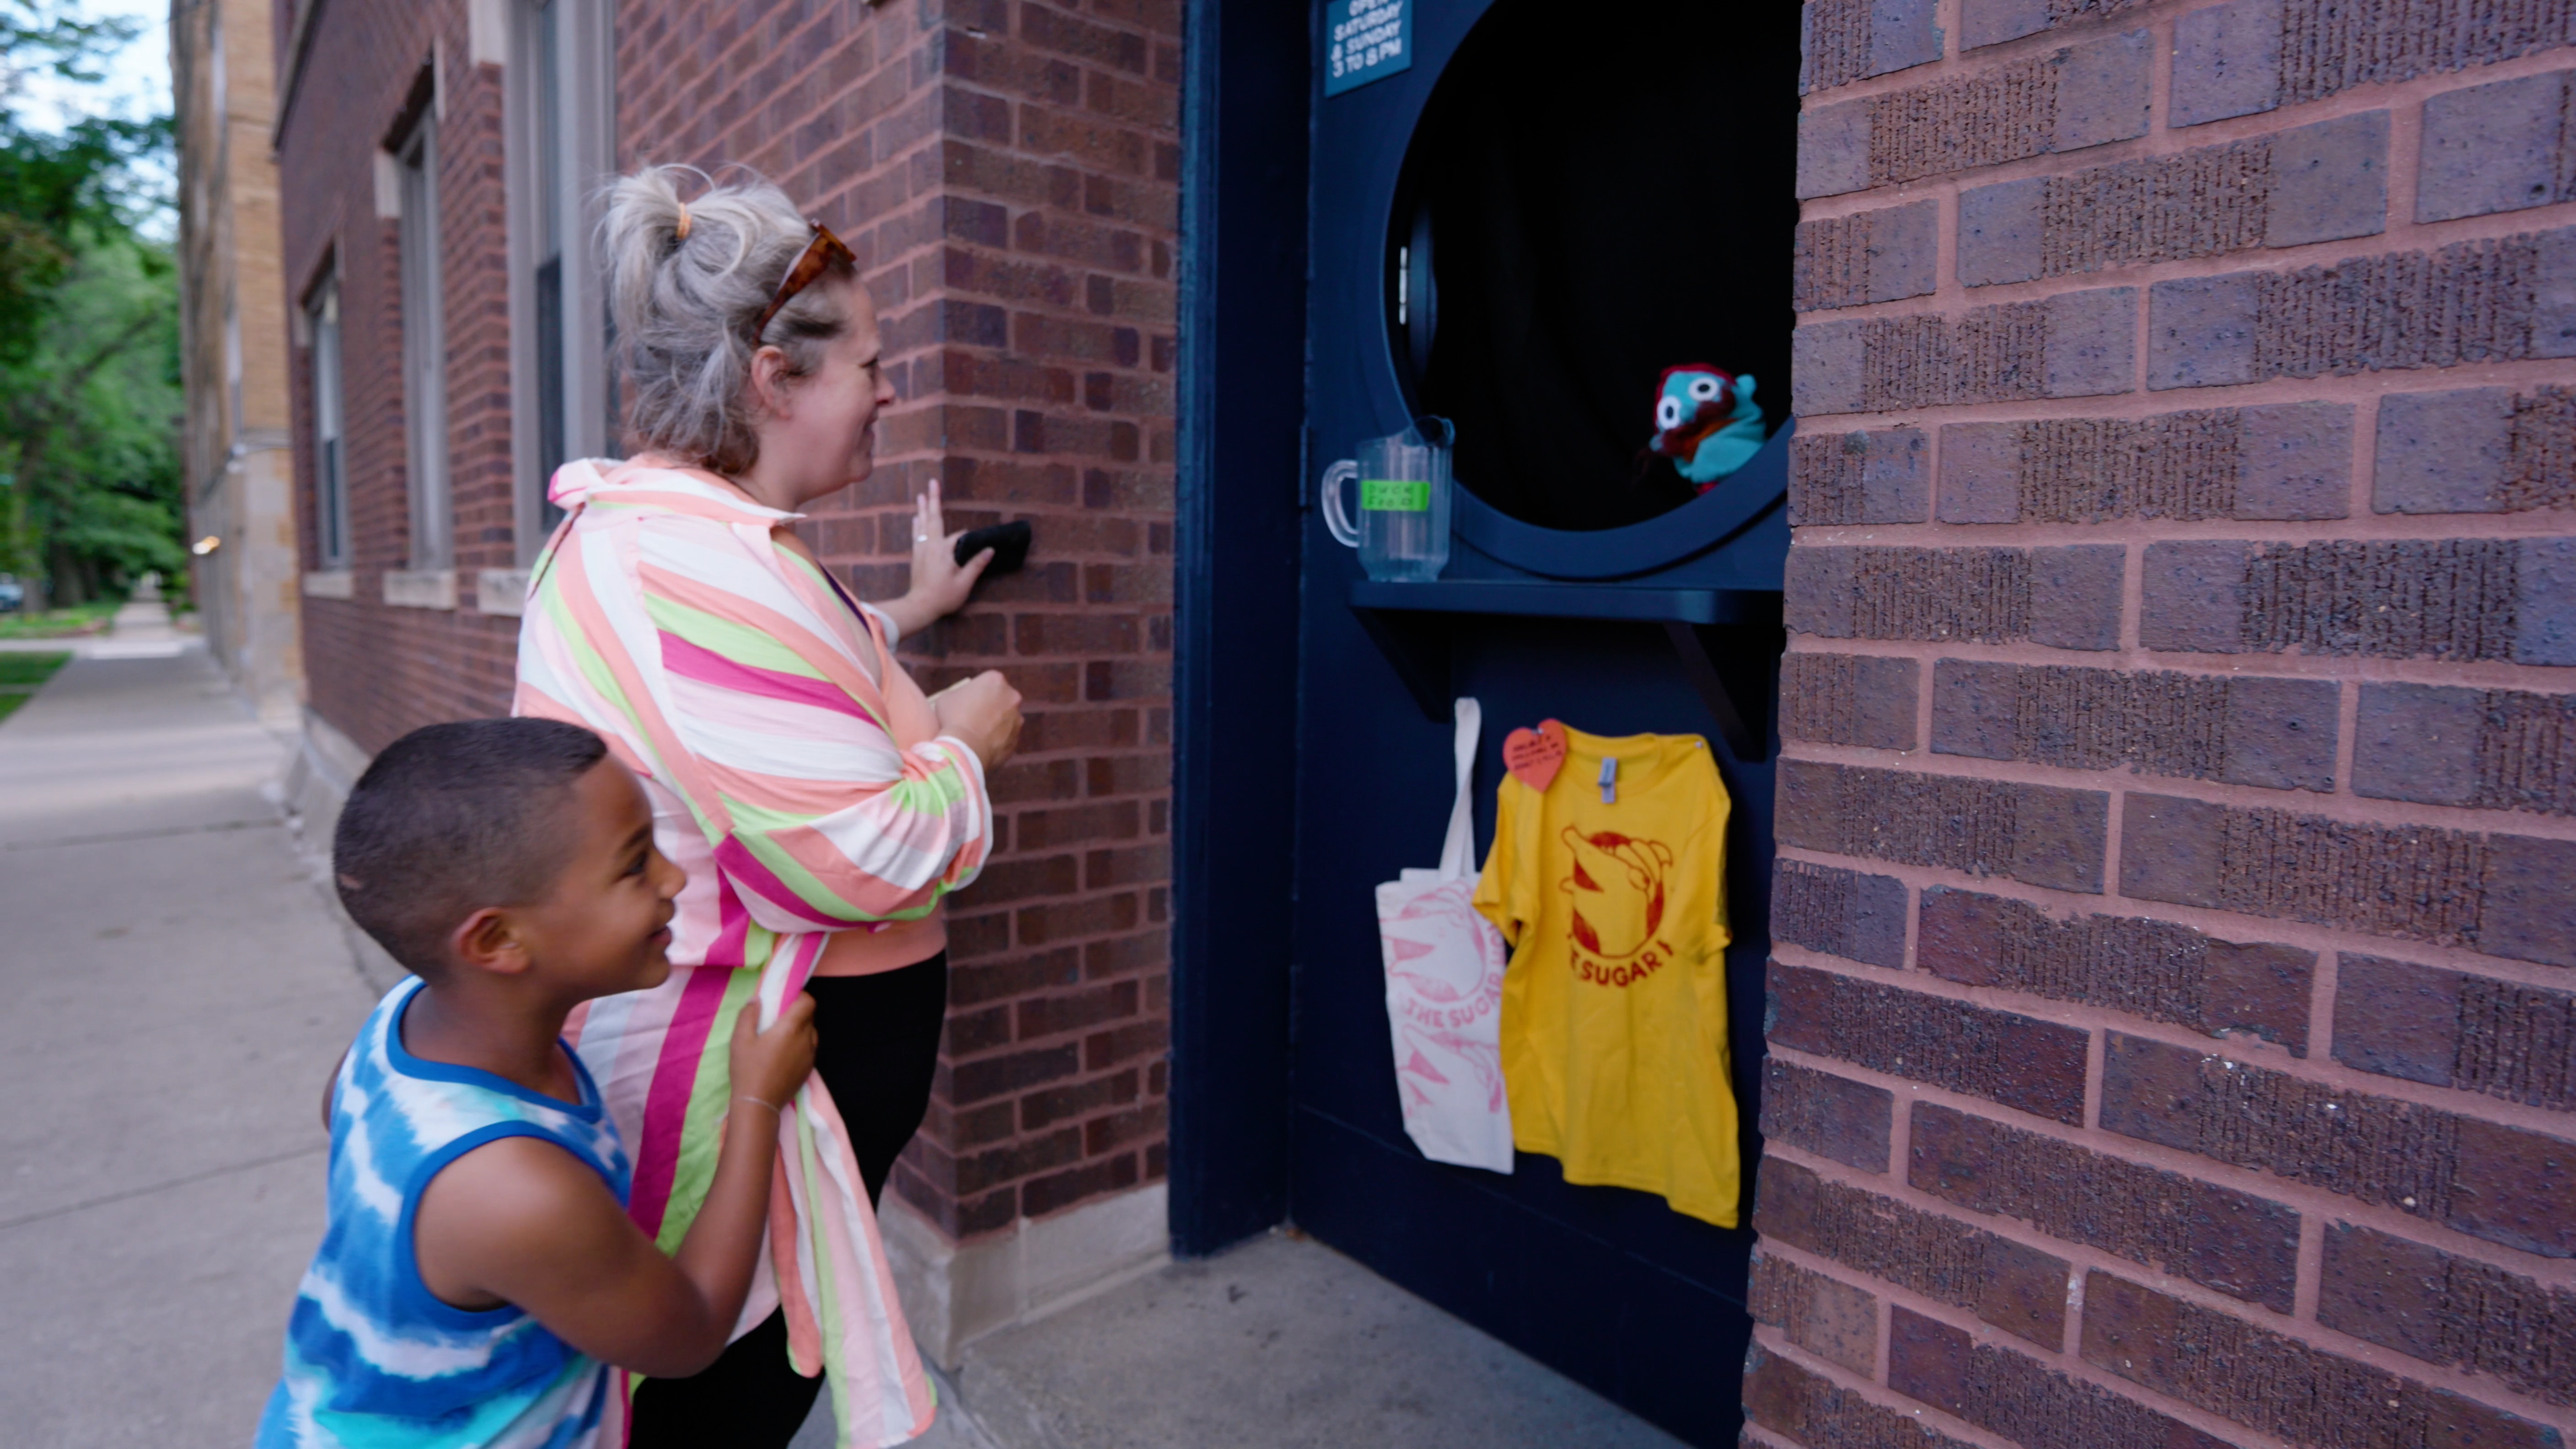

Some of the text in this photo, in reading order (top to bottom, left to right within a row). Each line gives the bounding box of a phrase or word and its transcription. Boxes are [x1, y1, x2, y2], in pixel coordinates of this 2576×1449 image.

[1334, 0, 1404, 42] SATURDAY
[1346, 19, 1402, 54] SUNDAY
[1332, 60, 1344, 78] 3
[1345, 52, 1363, 73] TO
[1379, 37, 1402, 61] PM
[1581, 951, 1664, 988] SUGAR
[1404, 996, 1444, 1028] THE
[1448, 972, 1502, 1028] SUGAR
